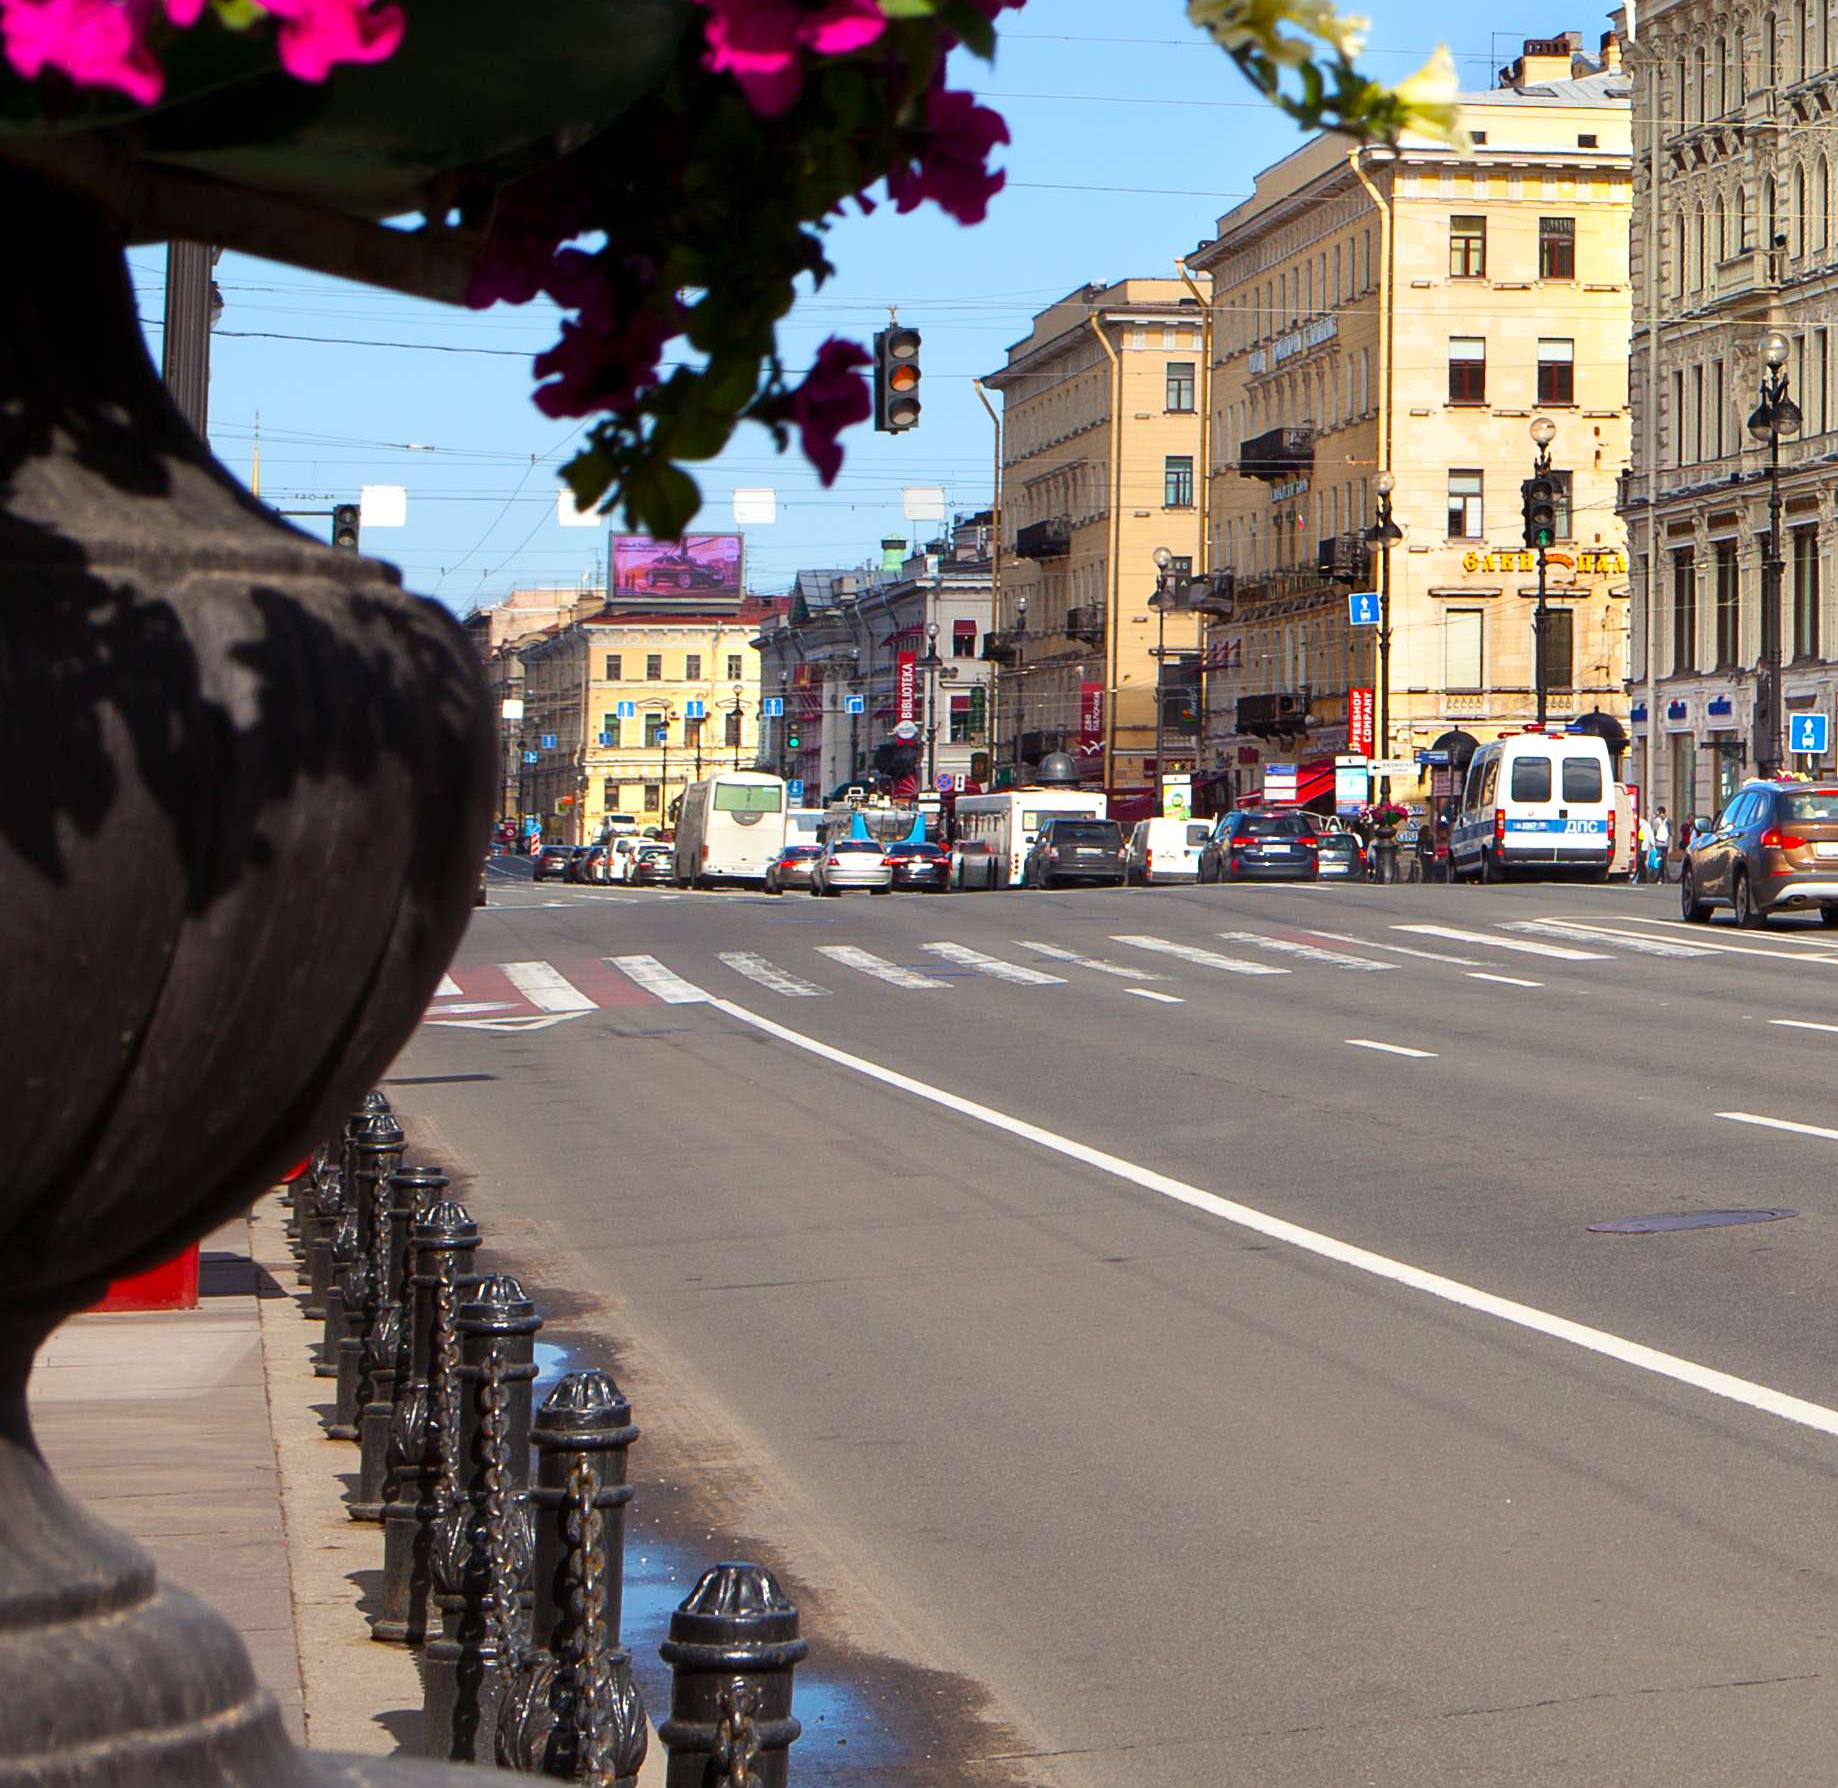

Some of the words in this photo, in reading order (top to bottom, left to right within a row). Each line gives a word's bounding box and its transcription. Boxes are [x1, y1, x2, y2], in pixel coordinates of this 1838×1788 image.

[901, 663, 913, 719] BIBLIOTEKA
[1363, 691, 1372, 743] COMPANY
[1564, 820, 1599, 834] ДПС
